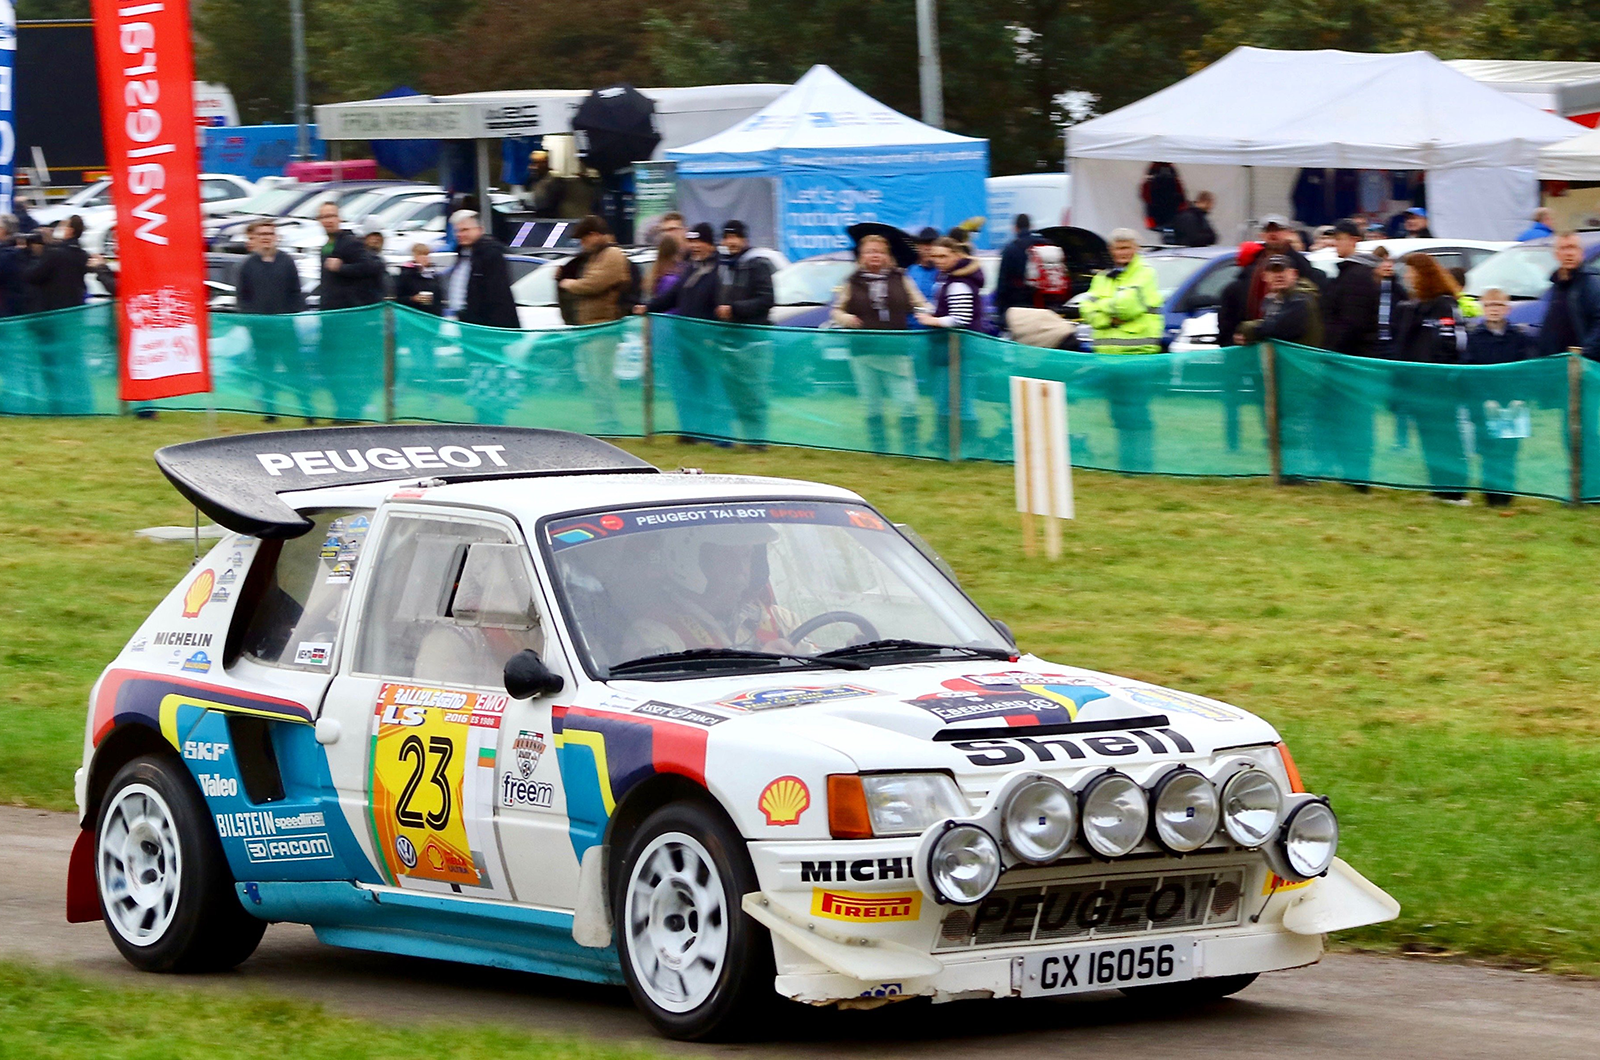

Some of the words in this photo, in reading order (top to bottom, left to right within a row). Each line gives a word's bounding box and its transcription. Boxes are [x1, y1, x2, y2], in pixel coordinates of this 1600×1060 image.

[255, 444, 509, 476] PEUGEOT
[636, 509, 707, 526] PEUGEOT
[709, 508, 766, 519] TALBOT
[769, 508, 816, 519] SPORT
[153, 631, 213, 647] MICHELIN
[474, 693, 507, 712] EMO
[931, 699, 1029, 718] EBERHARD
[381, 704, 426, 727] LS
[444, 712, 469, 723] 2016
[183, 740, 229, 761] SKF
[950, 728, 1196, 767] Shell
[198, 773, 237, 797] Valeo
[396, 734, 454, 831] 23
[503, 773, 553, 805] freem
[216, 811, 276, 838] BILSTEIN
[275, 812, 322, 830] speedline
[269, 838, 329, 858] FACOM
[821, 892, 913, 918] PIRELLI
[972, 873, 1212, 935] PEUGEOT
[1041, 954, 1080, 989] GX
[1088, 944, 1174, 984] 16056
